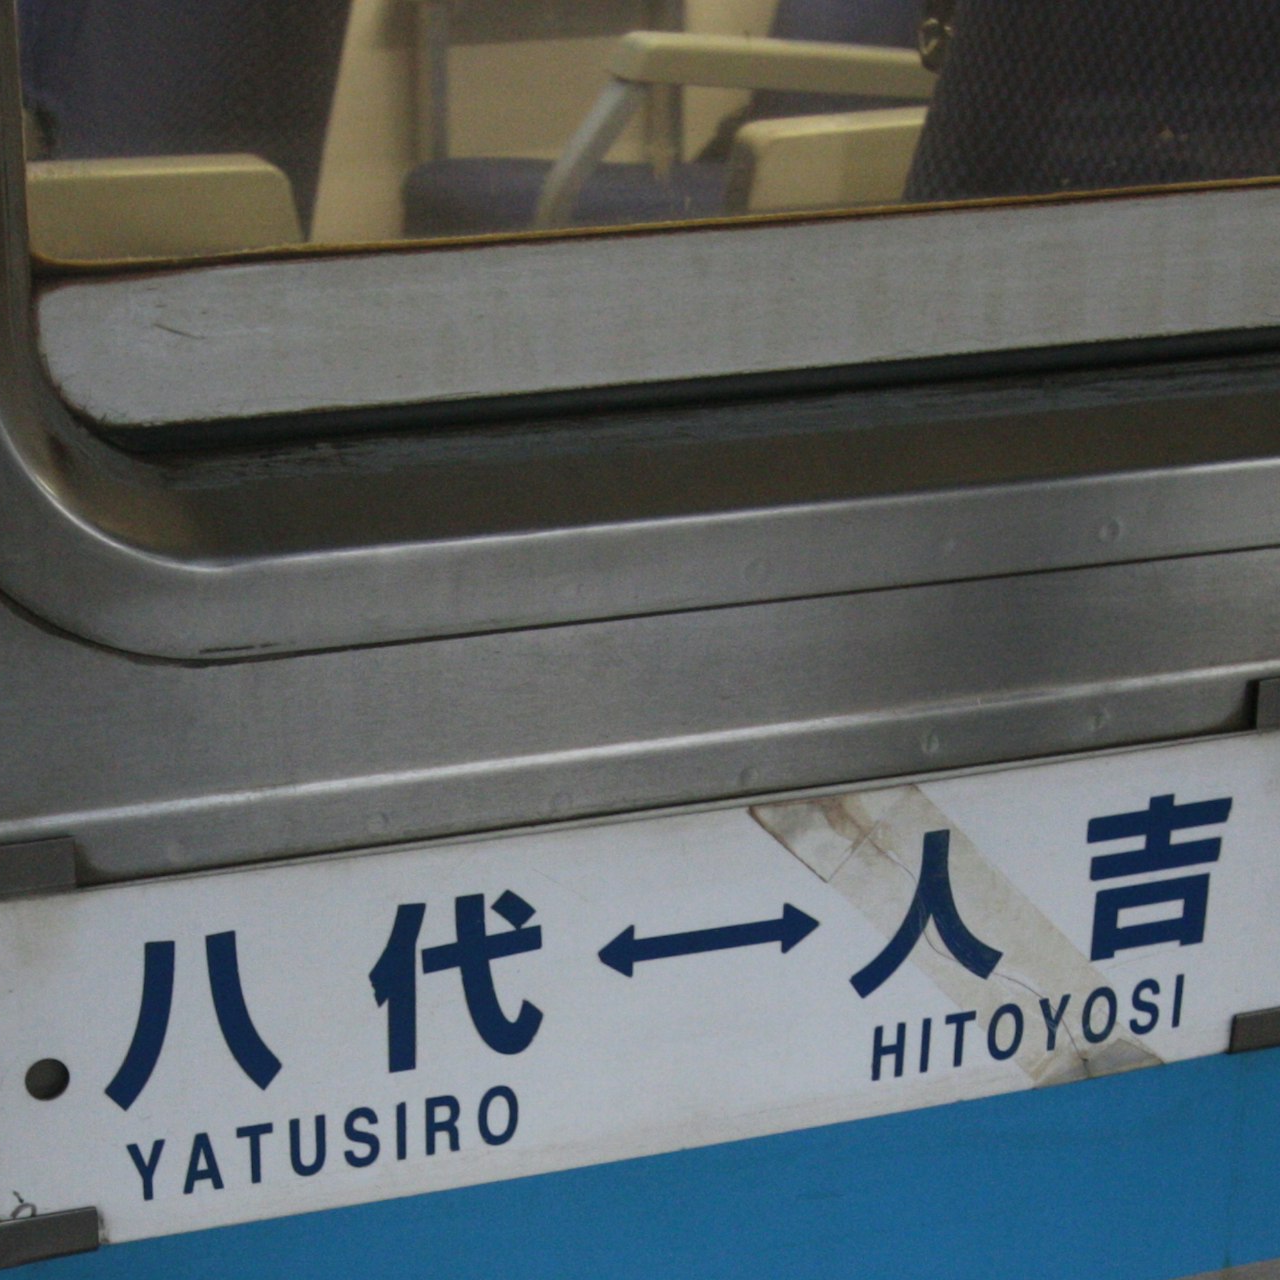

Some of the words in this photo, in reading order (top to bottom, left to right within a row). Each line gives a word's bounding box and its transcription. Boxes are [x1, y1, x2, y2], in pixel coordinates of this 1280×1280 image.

[105, 889, 543, 1111] 八代
[850, 793, 1232, 998] 人吉
[126, 1085, 520, 1200] YATUSIRO
[871, 974, 1184, 1081] HITOYOSI
